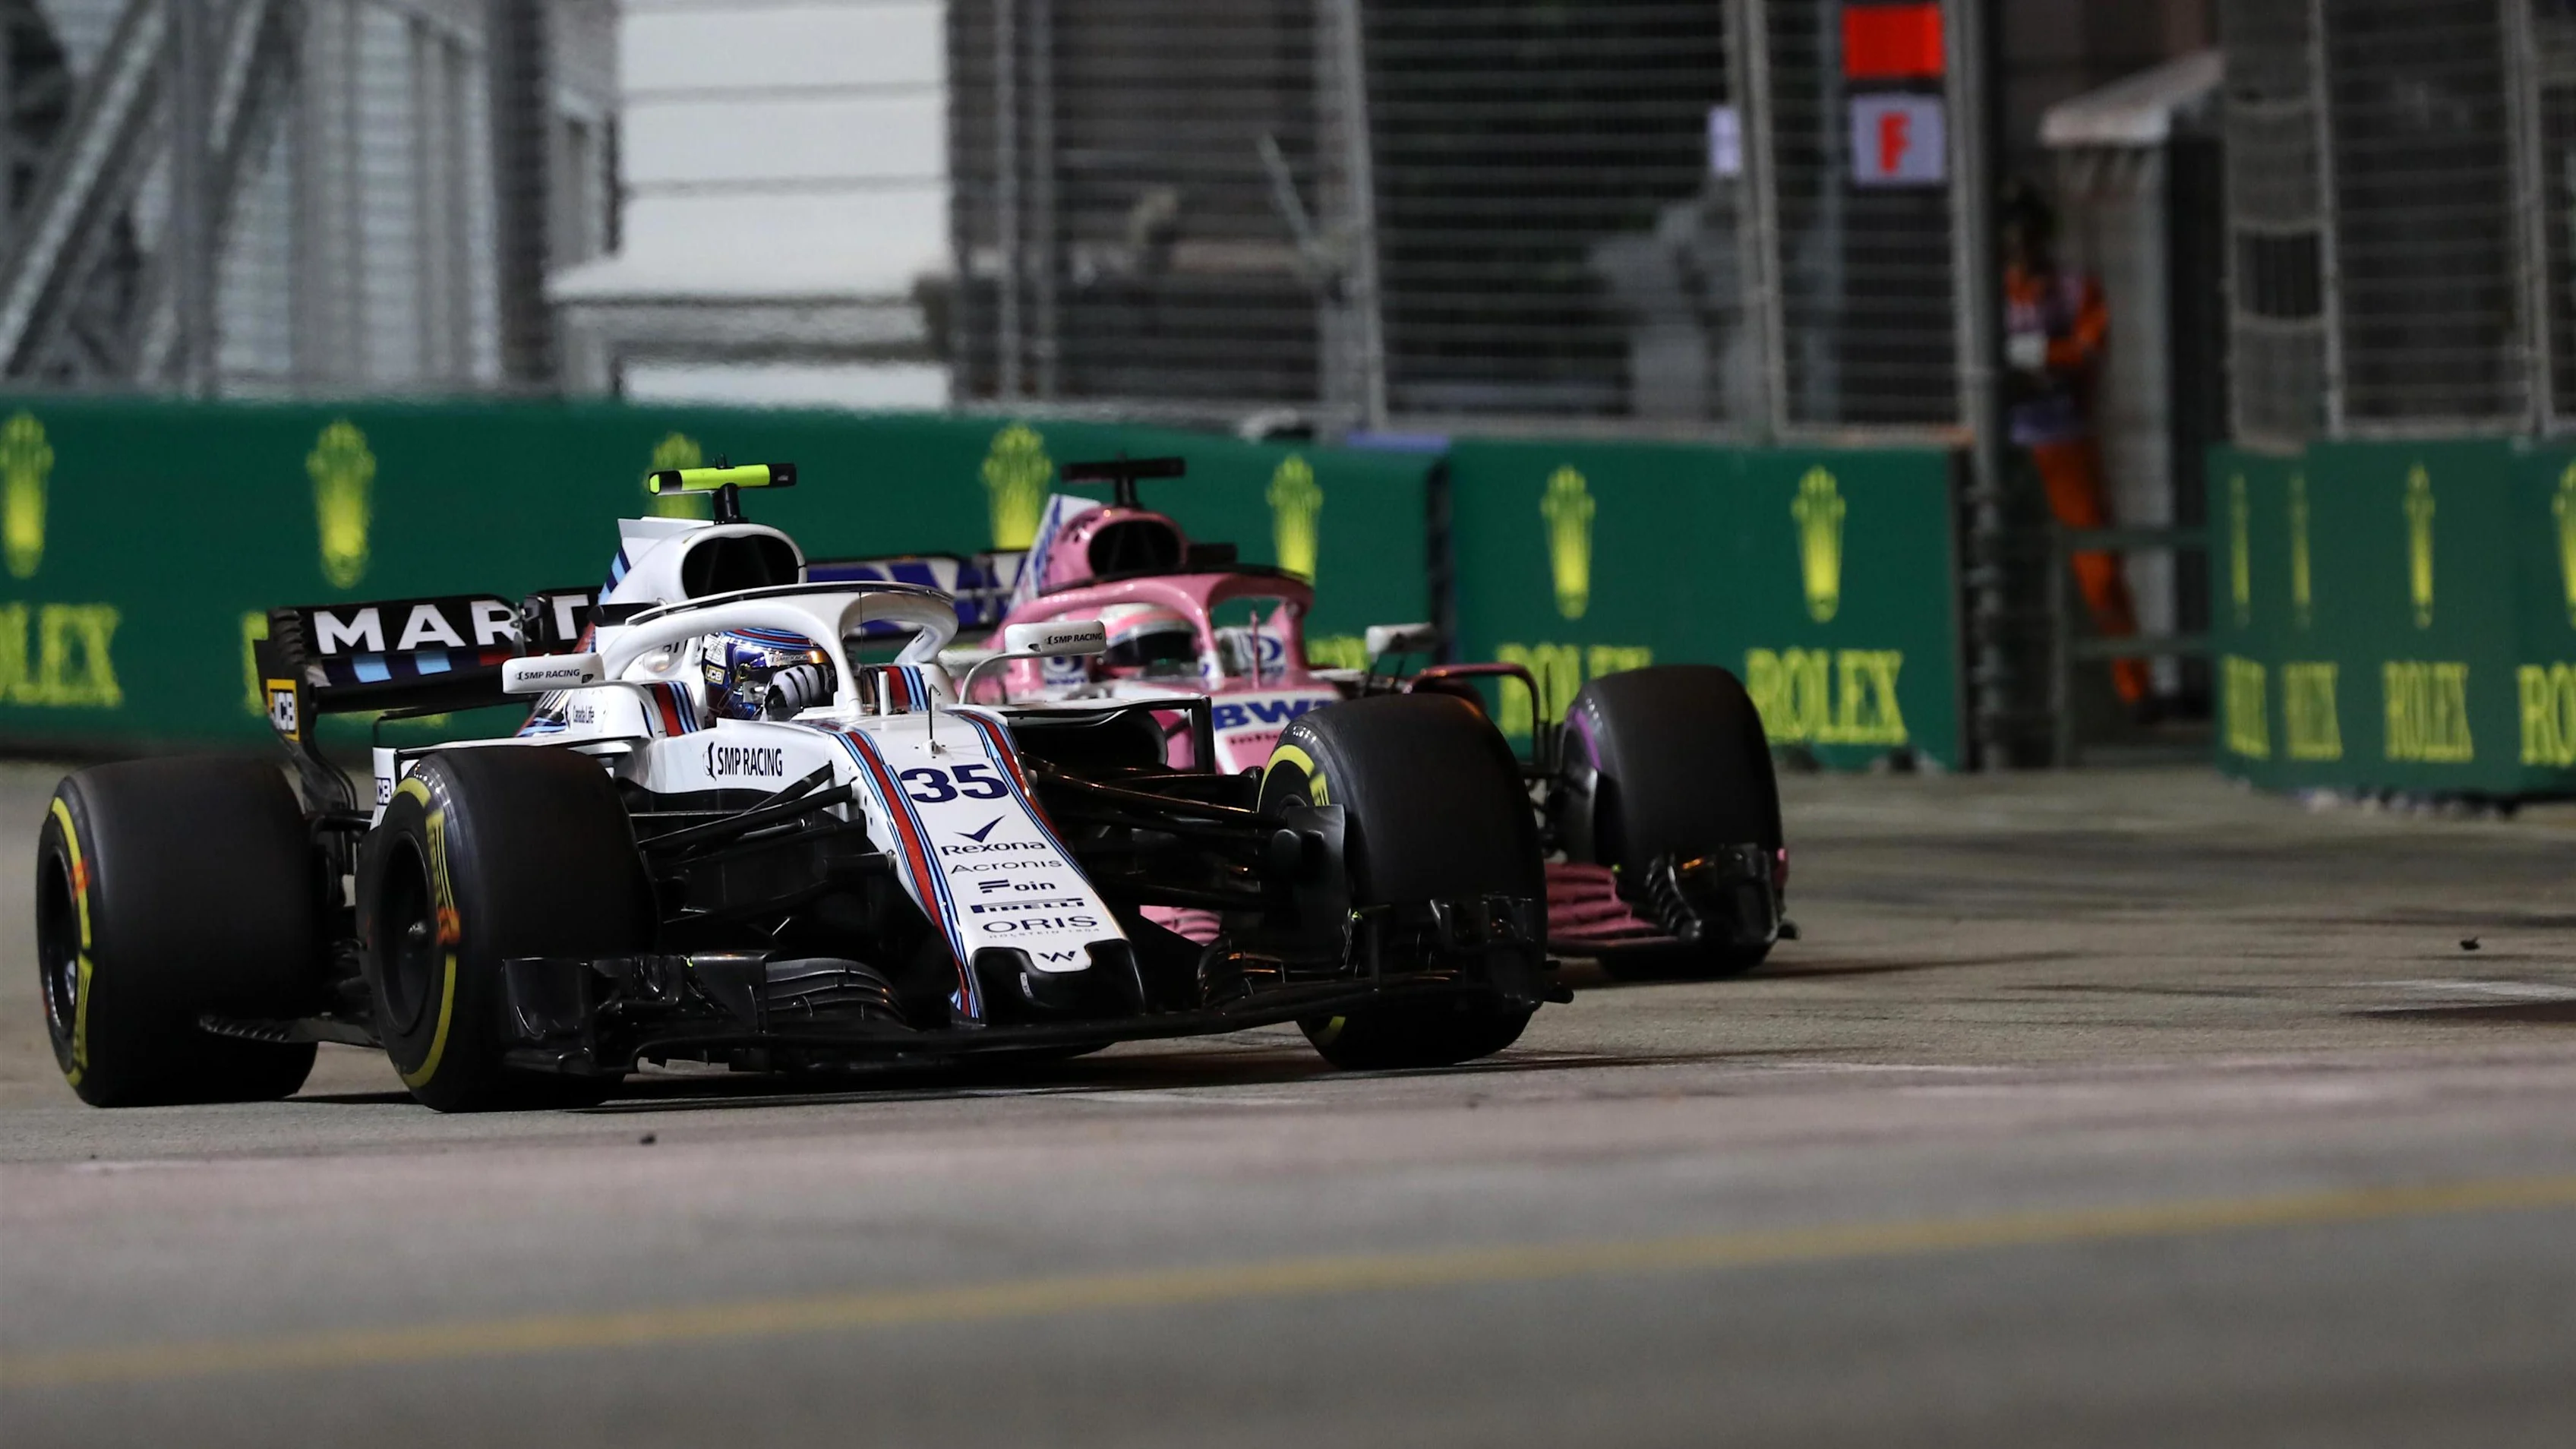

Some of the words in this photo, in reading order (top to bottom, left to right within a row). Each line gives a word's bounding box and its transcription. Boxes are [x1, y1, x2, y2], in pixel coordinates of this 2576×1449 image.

[1879, 112, 1910, 175] F
[1053, 636, 1072, 644] SMP
[1074, 633, 1103, 642] RACING
[524, 671, 544, 680] SMP
[545, 668, 580, 678] RACING
[1211, 699, 1334, 730] BW
[718, 747, 740, 776] SMP
[743, 748, 783, 776] RACING
[898, 763, 1009, 803] 35
[941, 841, 1046, 856] Rexona
[950, 860, 1062, 874] Acronis
[970, 898, 1085, 914] PIRELLI
[983, 916, 1098, 933] ORIS
